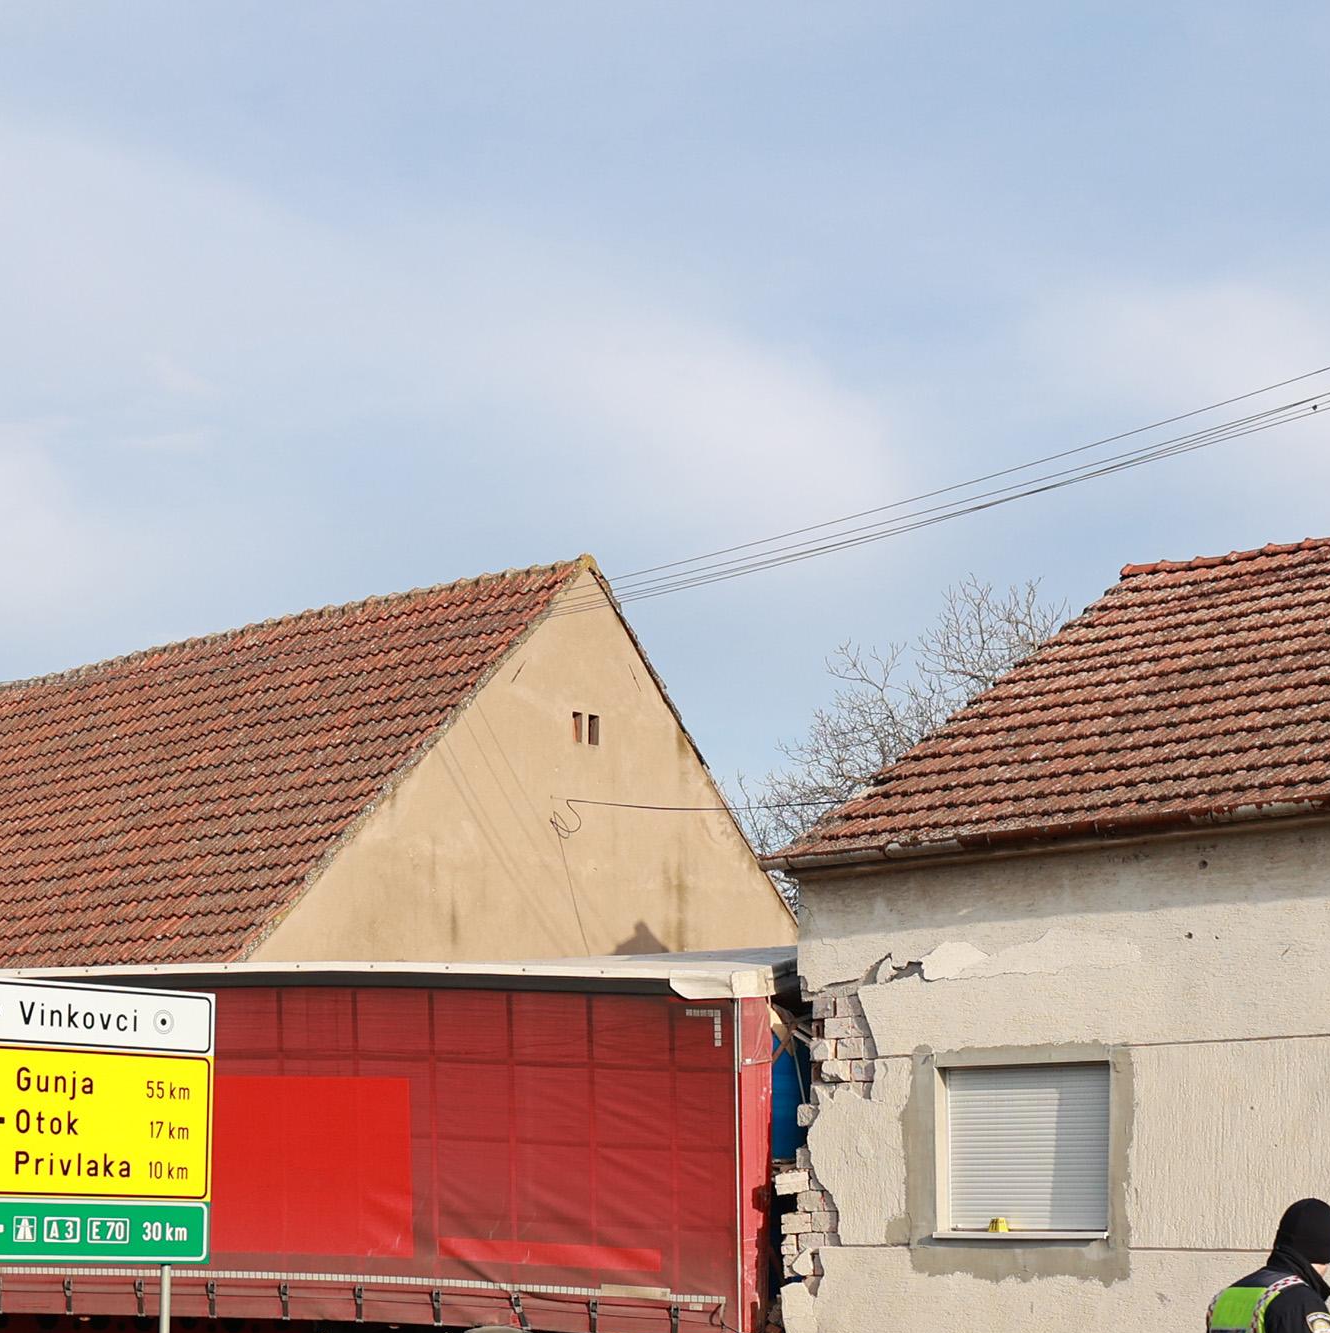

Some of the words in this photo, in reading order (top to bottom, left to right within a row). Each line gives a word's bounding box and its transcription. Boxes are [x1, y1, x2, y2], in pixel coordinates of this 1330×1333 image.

[19, 1000, 138, 1032] Vinkovci
[16, 1066, 94, 1101] Gunja
[145, 1080, 165, 1099] 55
[169, 1082, 190, 1101] km
[15, 1108, 79, 1136] Otok
[149, 1120, 164, 1139] 17
[168, 1122, 189, 1140] km
[15, 1150, 131, 1178] Privlaka
[148, 1161, 163, 1179] 10
[167, 1162, 189, 1180] km
[49, 1221, 59, 1239] A
[65, 1221, 74, 1239] 3
[91, 1220, 101, 1240] E
[106, 1221, 124, 1240] 70
[142, 1221, 162, 1241] 30
[165, 1221, 188, 1242] km
